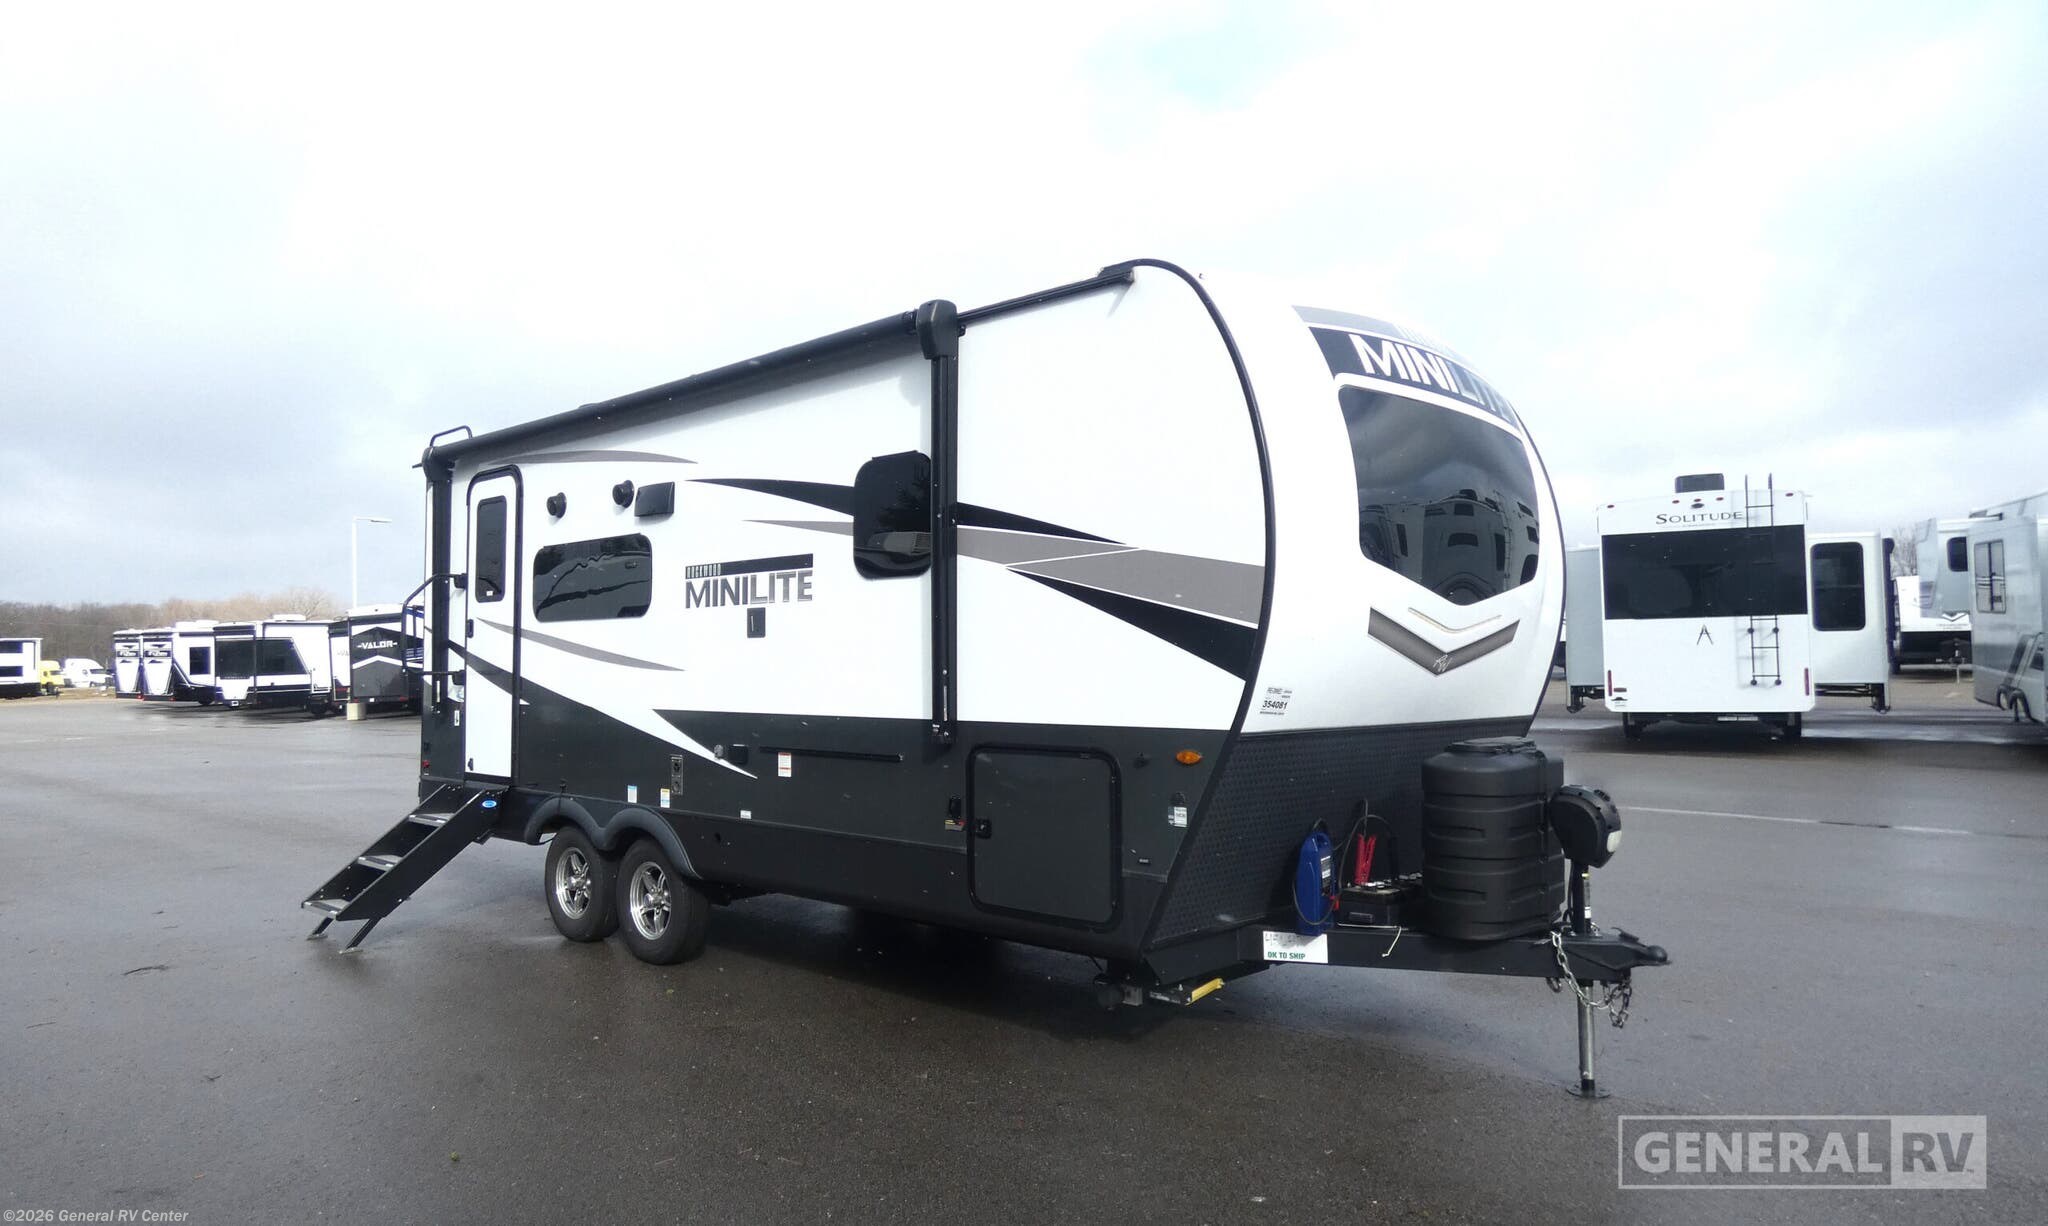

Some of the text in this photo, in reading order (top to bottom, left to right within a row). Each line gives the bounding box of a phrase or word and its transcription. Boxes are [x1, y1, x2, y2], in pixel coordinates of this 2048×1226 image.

[1655, 512, 1744, 525] SOLITUDE
[685, 570, 813, 608] MINILITE
[1267, 951, 1278, 959] OK
[1289, 952, 1306, 960] SHIP
